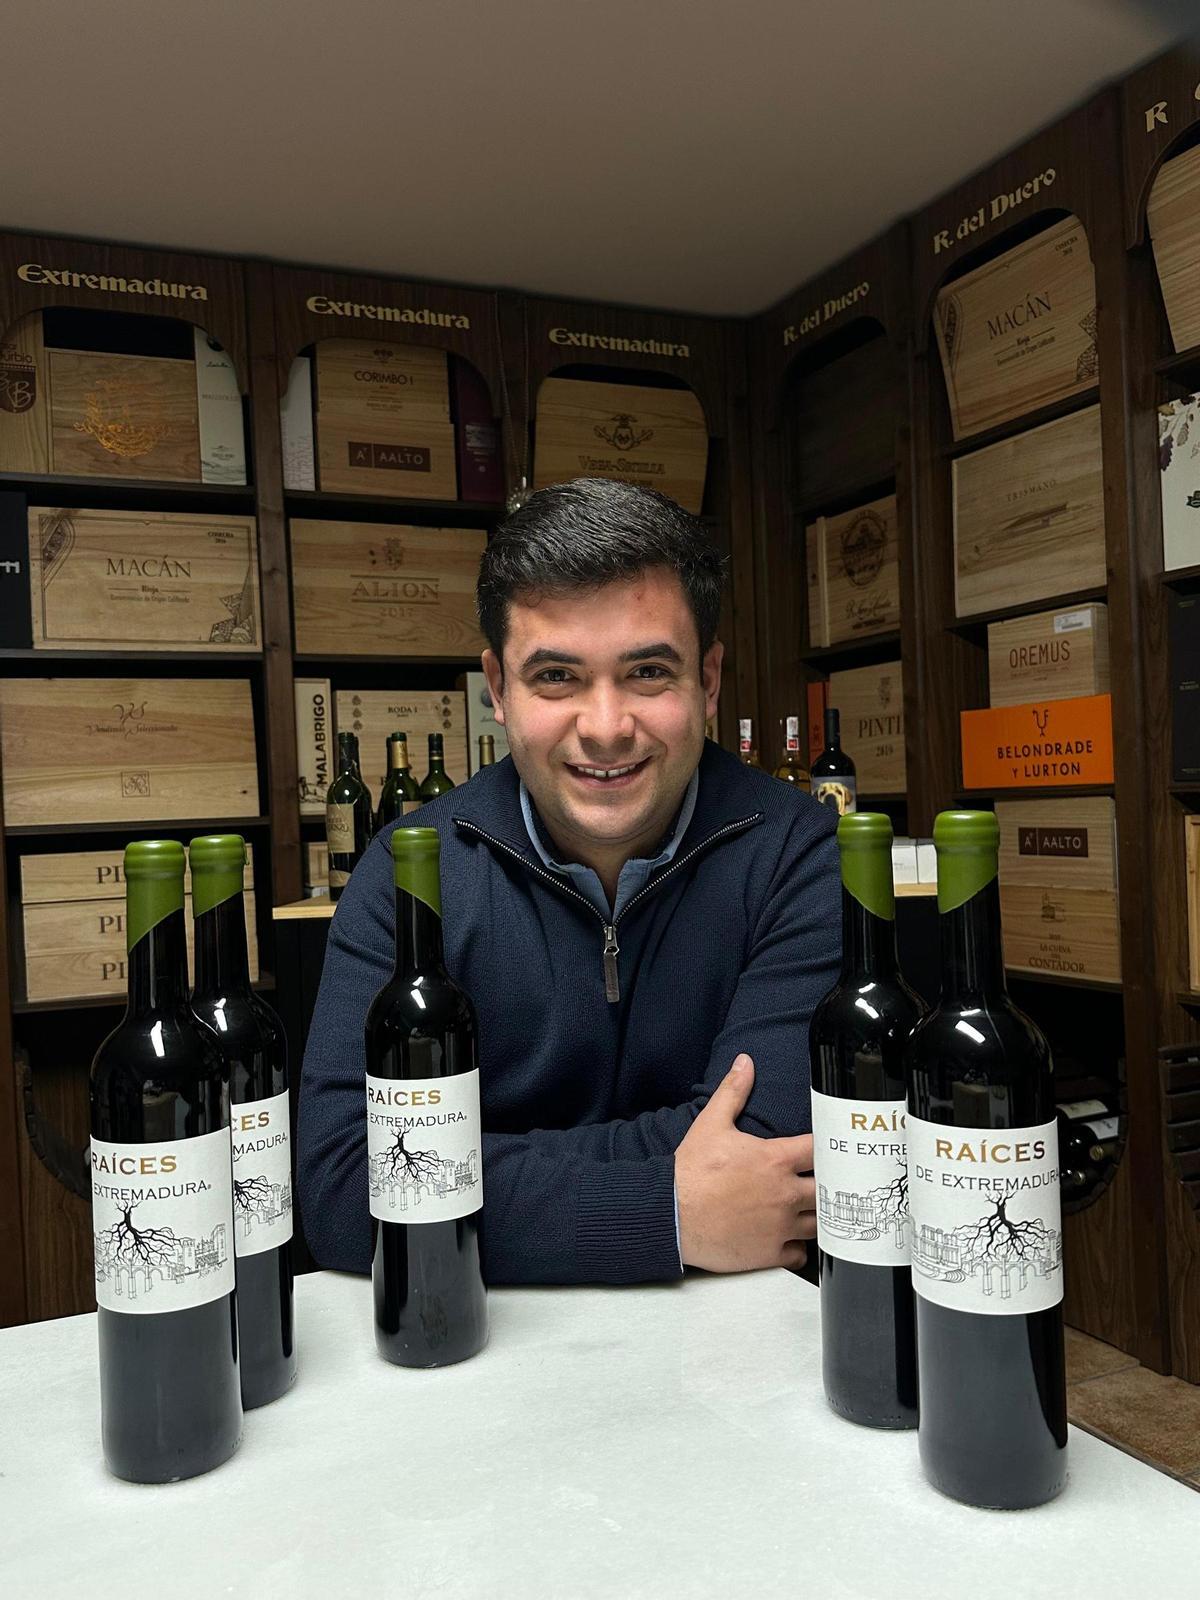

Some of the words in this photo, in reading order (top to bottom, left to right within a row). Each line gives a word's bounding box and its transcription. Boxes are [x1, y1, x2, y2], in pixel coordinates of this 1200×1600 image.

[933, 230, 954, 254] R.
[957, 207, 985, 239] del
[990, 168, 1056, 222] Duero
[17, 263, 208, 301] Extremadura
[306, 296, 470, 330] Extremadura
[800, 310, 819, 335] del
[824, 281, 869, 320] Duero
[985, 291, 1051, 340] MACÁN
[549, 328, 690, 357] Extremadura
[354, 370, 408, 386] CORIMBO
[380, 451, 424, 465] AALTO
[106, 554, 191, 578] MACÁN
[351, 581, 439, 600] ALION
[1009, 640, 1071, 669] OREMUS
[312, 693, 329, 786] MALABRIGO
[997, 740, 1093, 760] BELONDRADE
[1024, 762, 1081, 778] LURTON
[1042, 836, 1081, 849] AALTO
[1028, 956, 1086, 973] CONTADOR
[368, 1086, 442, 1106] RAÍCES
[829, 1138, 848, 1152] DE
[935, 1138, 1045, 1164] RAÍCES
[92, 1152, 177, 1176] RAÍCES
[916, 1165, 933, 1182] DE
